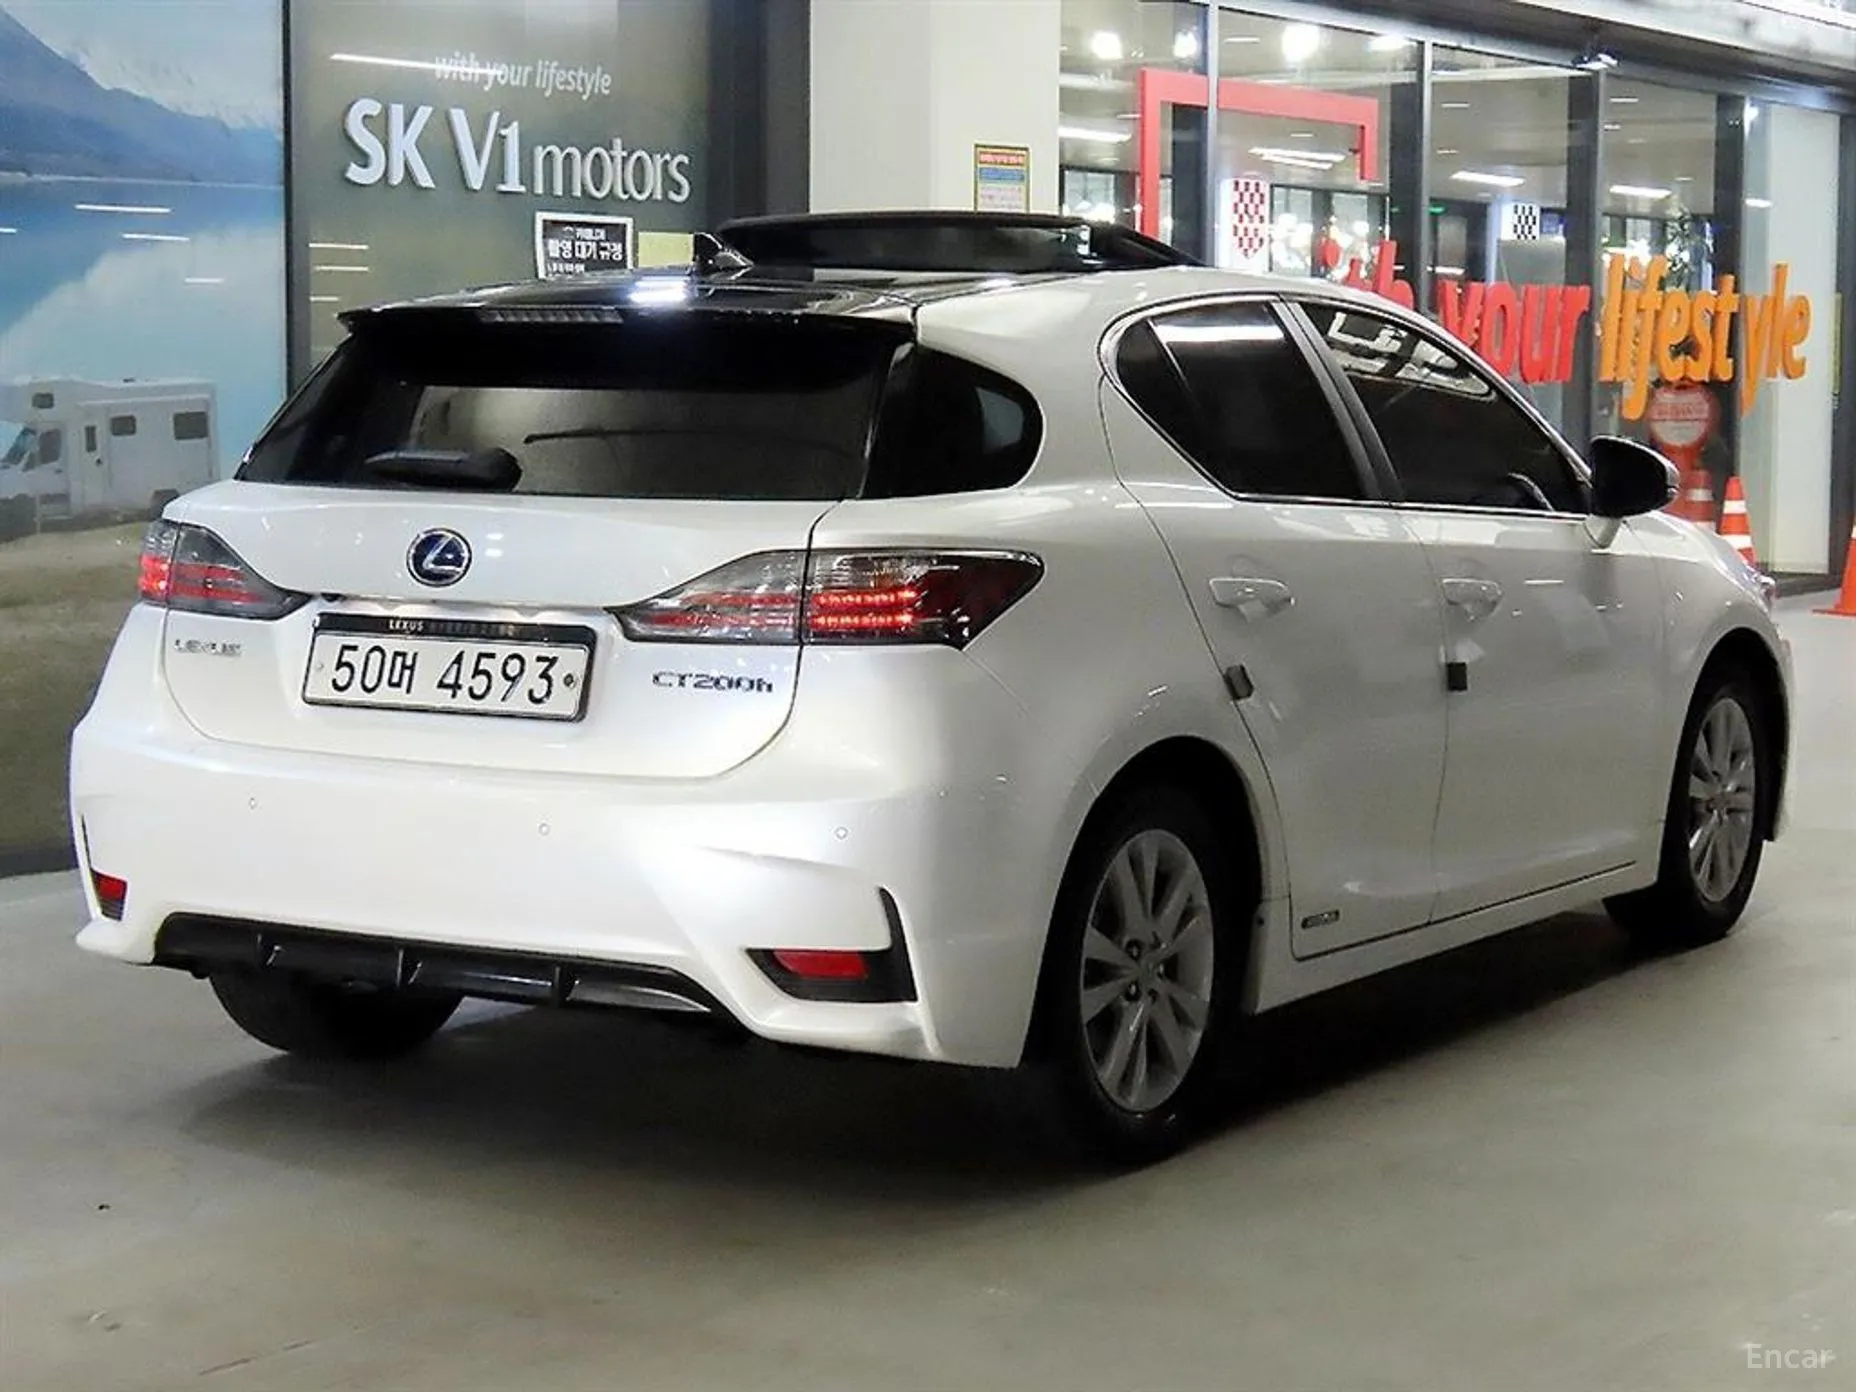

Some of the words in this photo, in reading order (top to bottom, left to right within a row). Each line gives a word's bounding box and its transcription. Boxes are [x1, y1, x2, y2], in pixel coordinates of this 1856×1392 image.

[434, 51, 480, 82] with
[482, 60, 533, 92] your
[535, 59, 612, 100] lifestyle
[344, 98, 436, 190] SK
[533, 138, 691, 203] motors
[1598, 253, 1812, 420] lifestyle
[388, 618, 425, 632] LEXUS
[331, 644, 419, 695] 50머
[436, 650, 559, 704] 4593
